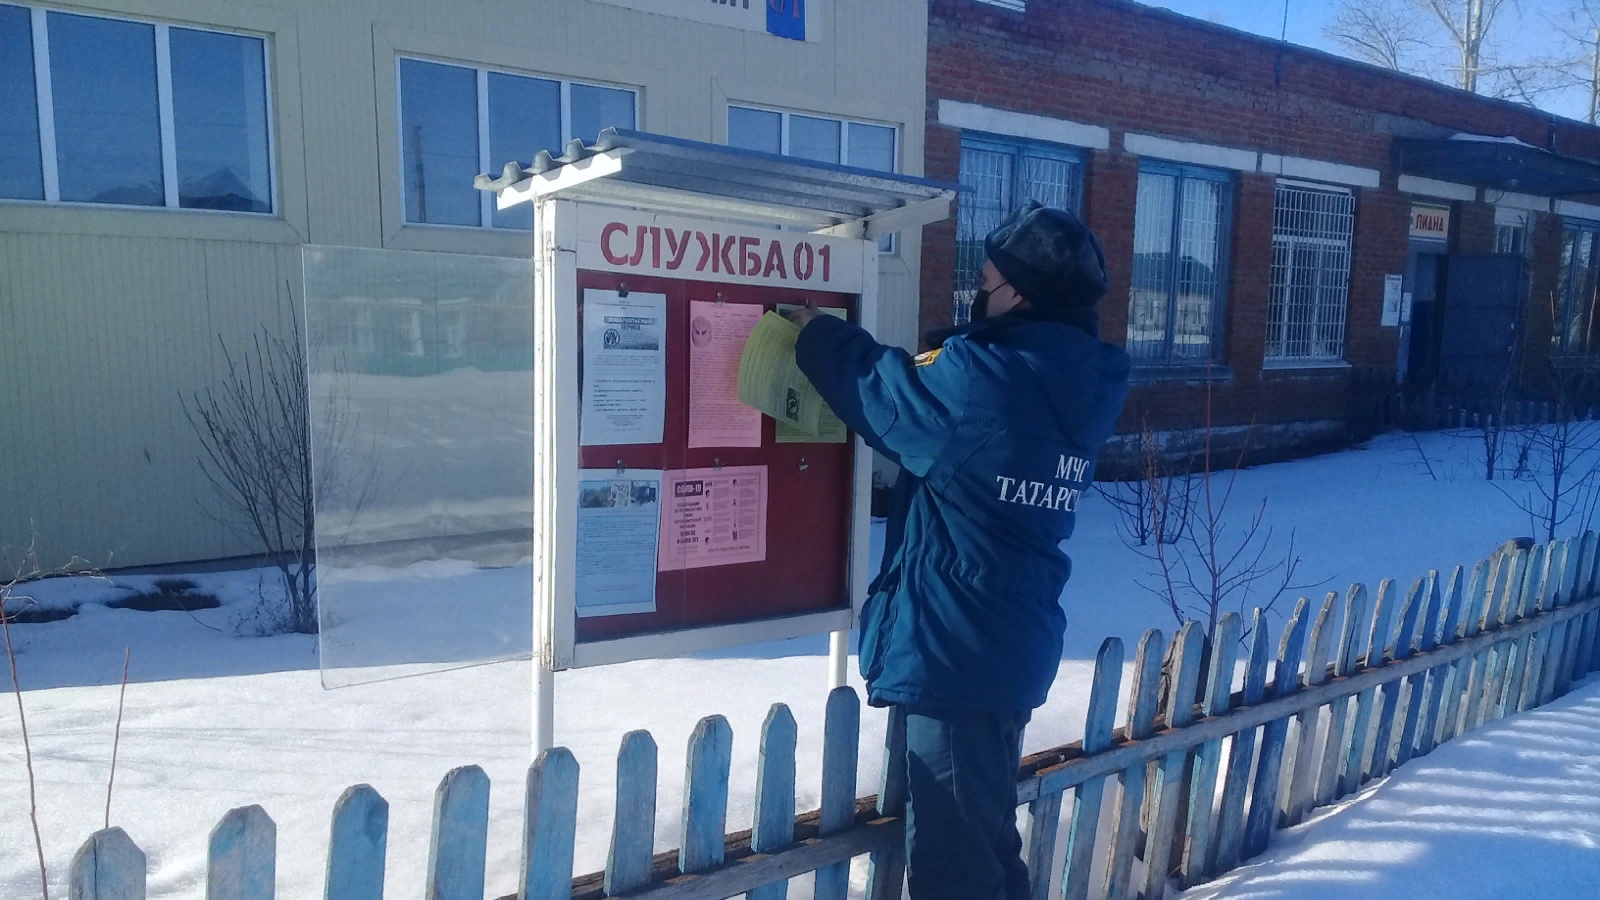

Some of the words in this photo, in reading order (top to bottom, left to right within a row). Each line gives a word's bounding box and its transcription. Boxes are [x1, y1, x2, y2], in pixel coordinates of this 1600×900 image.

[600, 221, 788, 280] СЛУЖБА
[793, 240, 831, 283] 01
[1054, 453, 1090, 483] МЧС
